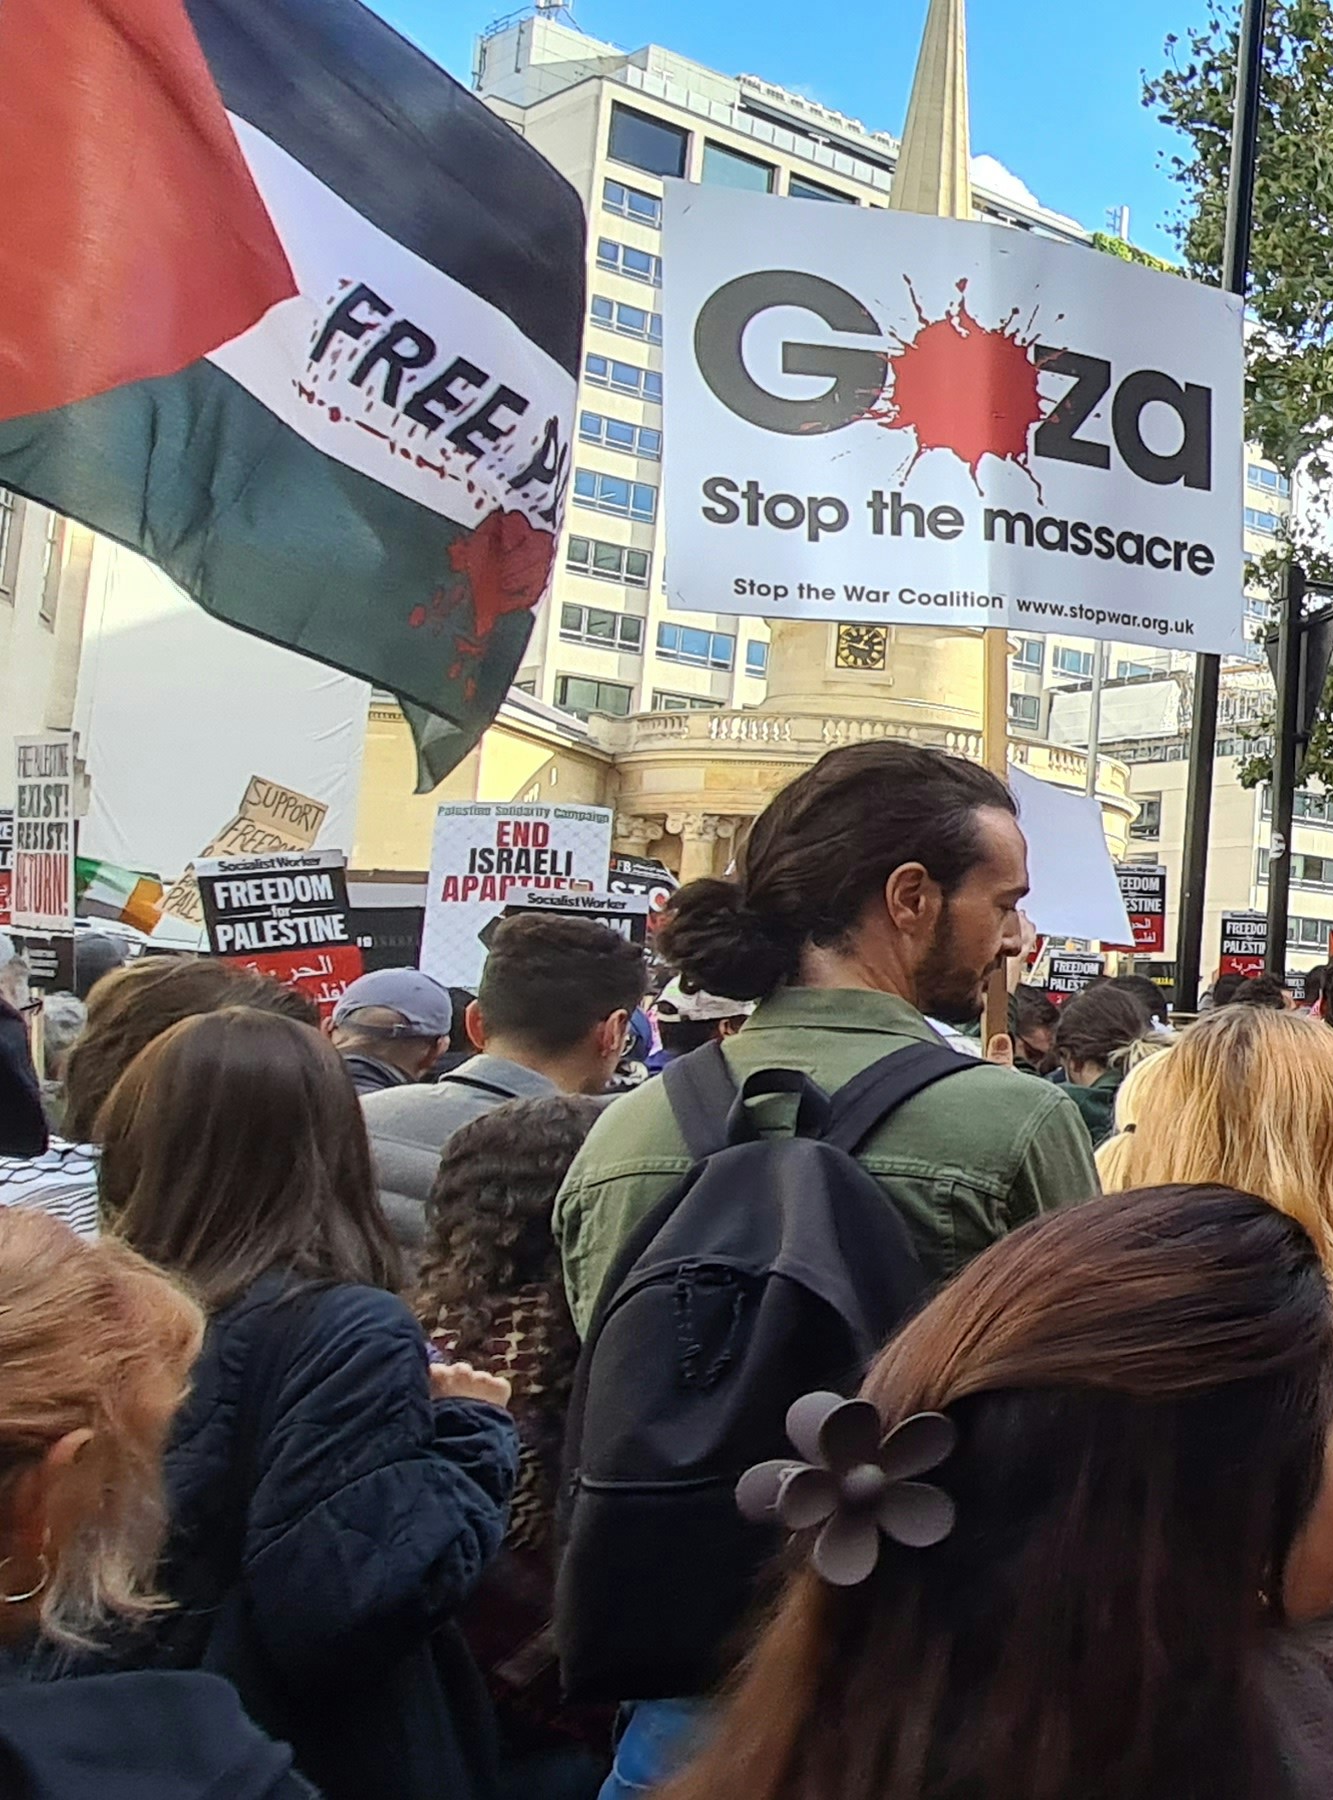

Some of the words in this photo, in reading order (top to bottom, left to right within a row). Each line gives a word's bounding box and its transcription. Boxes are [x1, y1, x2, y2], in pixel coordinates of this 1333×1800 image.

[309, 281, 531, 459] FREE
[693, 268, 1213, 493] Gza
[702, 476, 850, 542] Stop
[866, 490, 965, 541] the
[983, 507, 1216, 577] massacre
[733, 578, 789, 602] Stop
[797, 582, 836, 601] the
[842, 584, 891, 604] War
[898, 588, 1004, 609] Coalition
[1016, 598, 1195, 636] www.stopwar.org.uk
[248, 778, 326, 832] SUPPORT
[496, 820, 550, 848] END
[468, 847, 573, 877] ISRAELI
[213, 873, 335, 910] FREEDOM
[1119, 876, 1160, 892] EEDOM
[270, 904, 291, 918] for
[1124, 898, 1162, 913] ESTINE
[215, 913, 349, 953] PALESTINE
[1226, 921, 1267, 936] FREEDO
[1223, 940, 1266, 955] PALESTI
[1053, 960, 1100, 975] FREEDOM
[1049, 977, 1091, 993] PALEST
